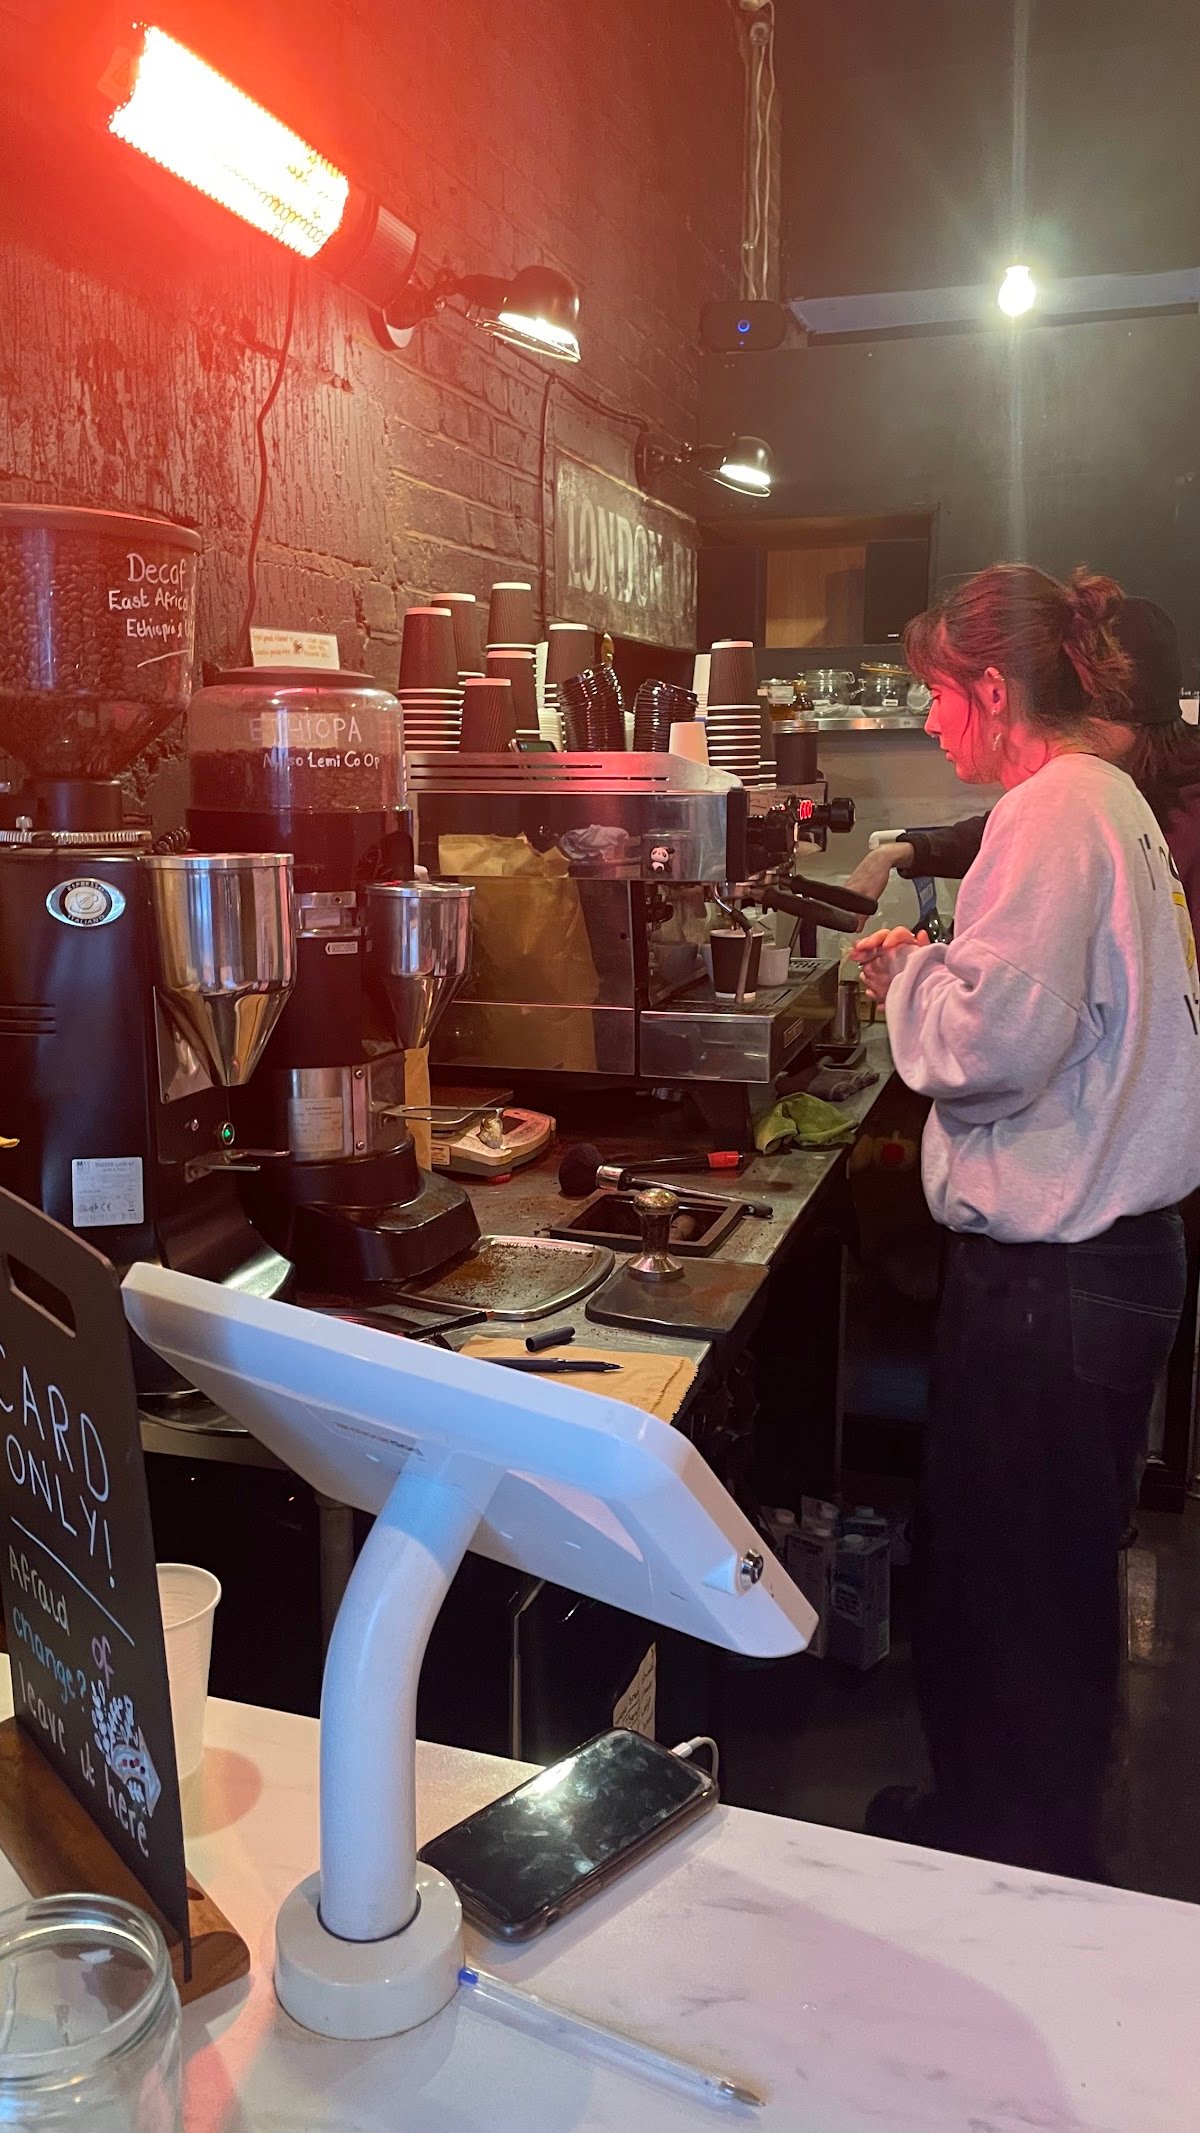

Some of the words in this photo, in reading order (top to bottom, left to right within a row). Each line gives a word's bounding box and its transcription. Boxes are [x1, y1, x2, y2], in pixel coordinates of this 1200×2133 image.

[126, 552, 187, 592] Decaf
[567, 498, 663, 613] LONDON
[108, 587, 150, 611] East
[126, 617, 176, 643] Ethiopia
[307, 750, 341, 768] Lemi
[344, 750, 361, 768] Co
[364, 753, 381, 770] Op
[67, 914, 105, 925] ITALIANO
[6, 1433, 116, 1589] ONLY!
[7, 1544, 71, 1637] Afraid
[90, 1634, 115, 1690] of
[12, 1605, 87, 1713] change?
[17, 1658, 66, 1756] leave
[79, 1740, 96, 1788] it
[103, 1764, 150, 1859] here
